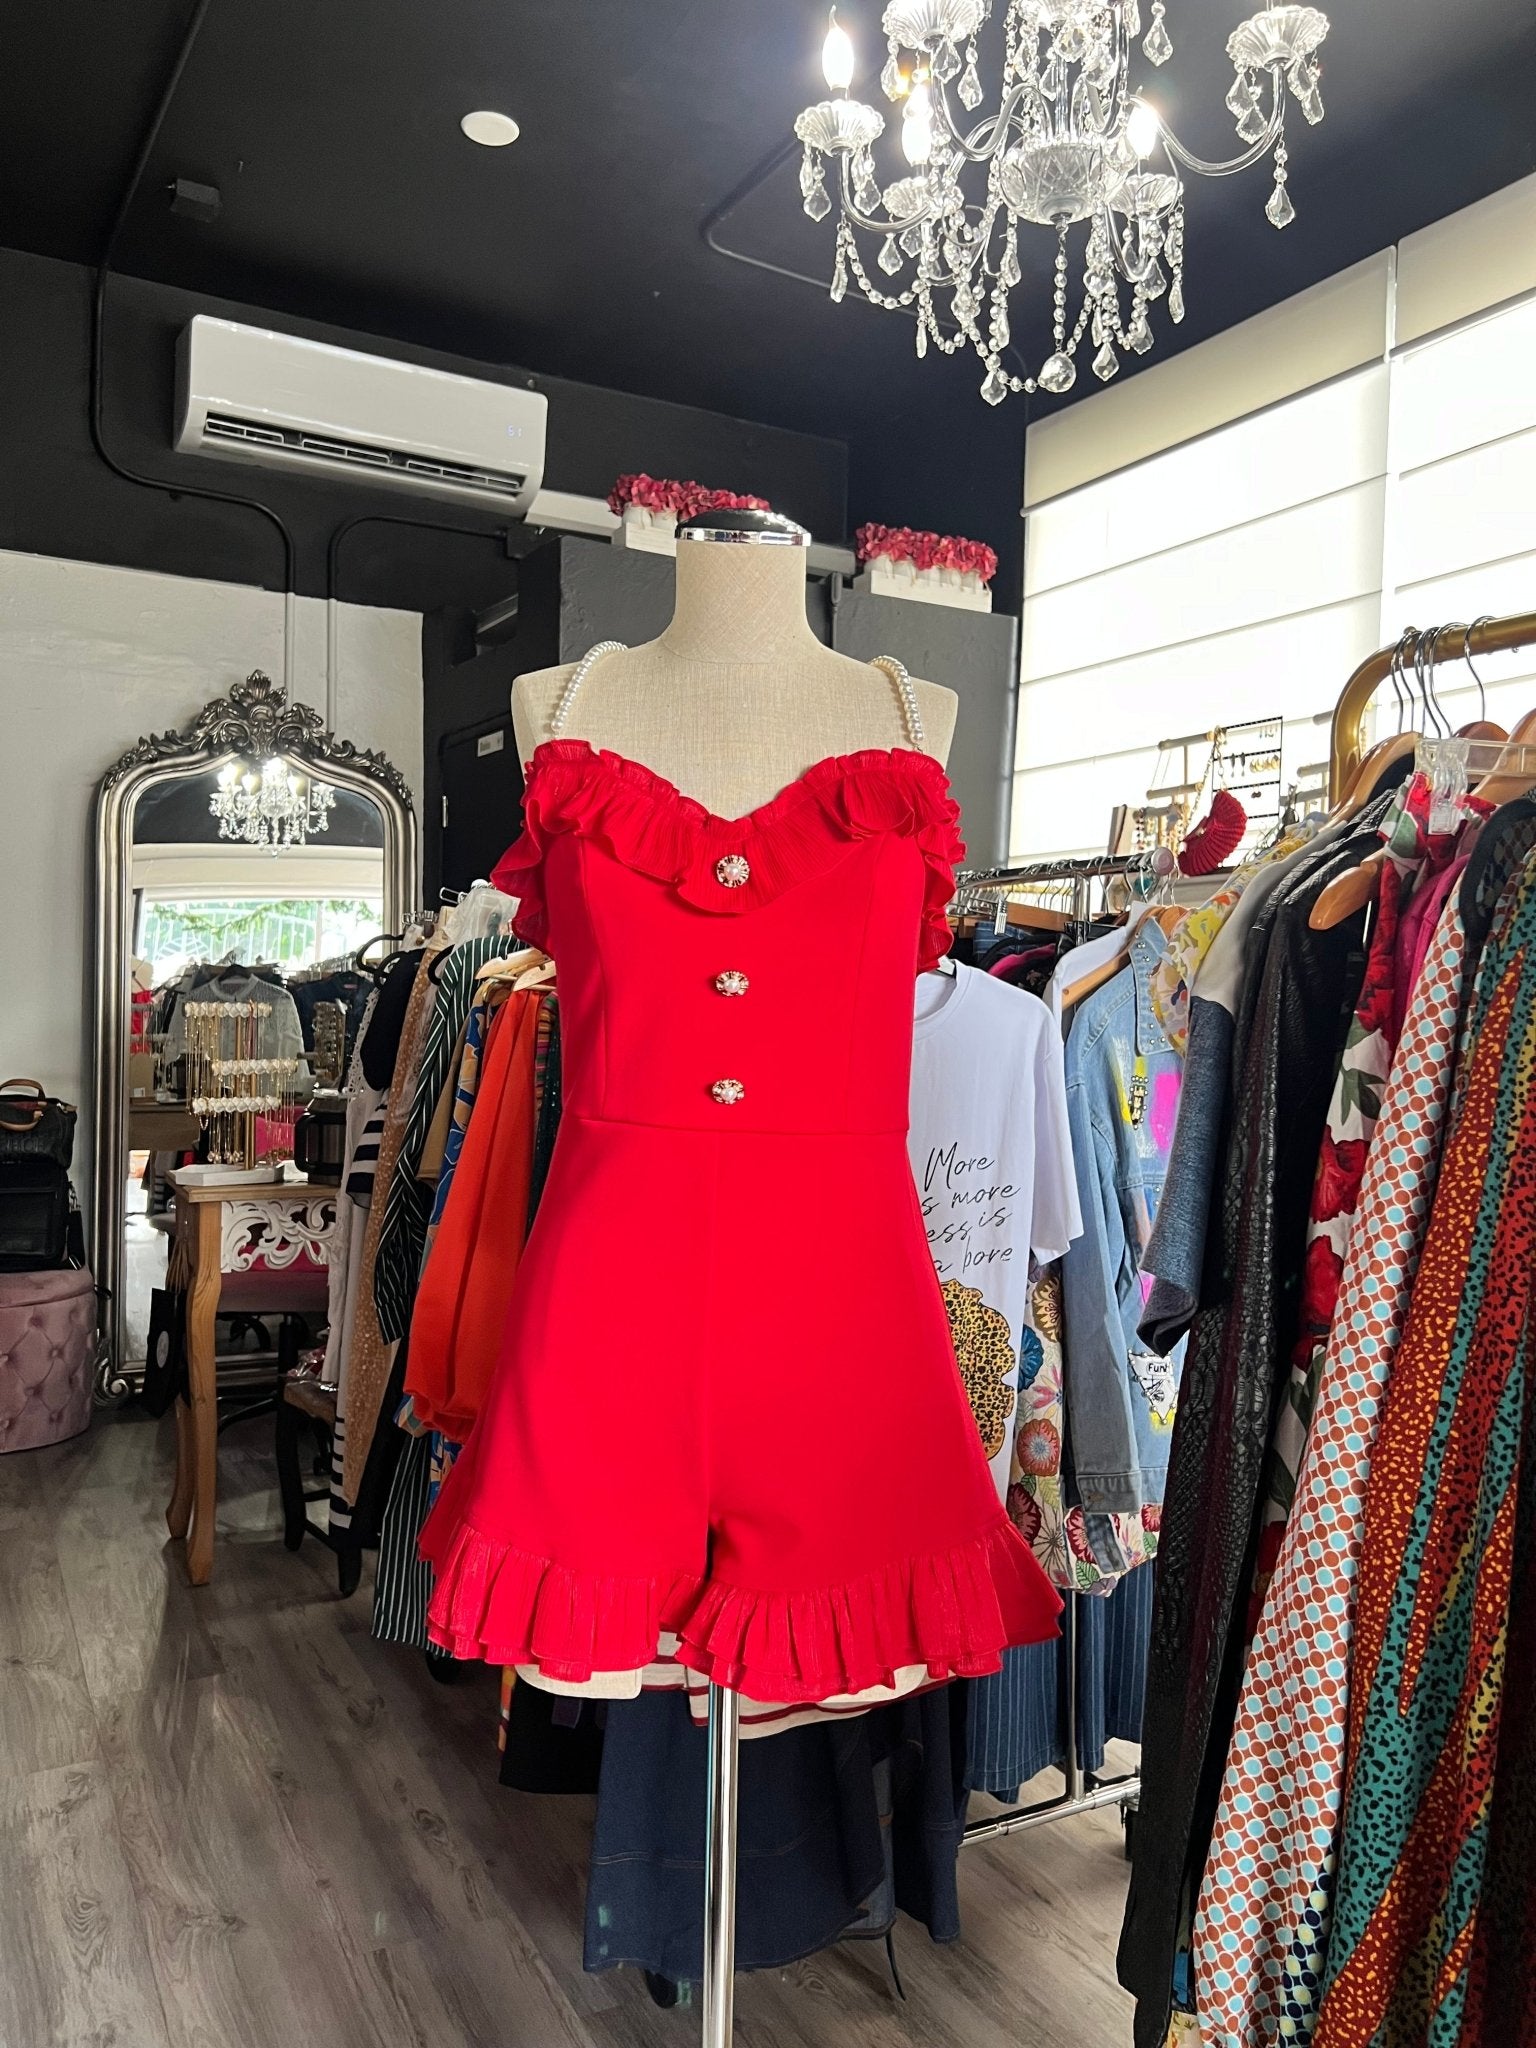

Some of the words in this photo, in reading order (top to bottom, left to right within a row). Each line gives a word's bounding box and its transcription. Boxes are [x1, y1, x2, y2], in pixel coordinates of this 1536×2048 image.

[924, 1141, 994, 1192] More
[921, 1196, 939, 1216] s
[951, 1184, 1021, 1209] more
[926, 1221, 973, 1244] ess
[978, 1207, 1012, 1227] is
[962, 1236, 1014, 1274] bore
